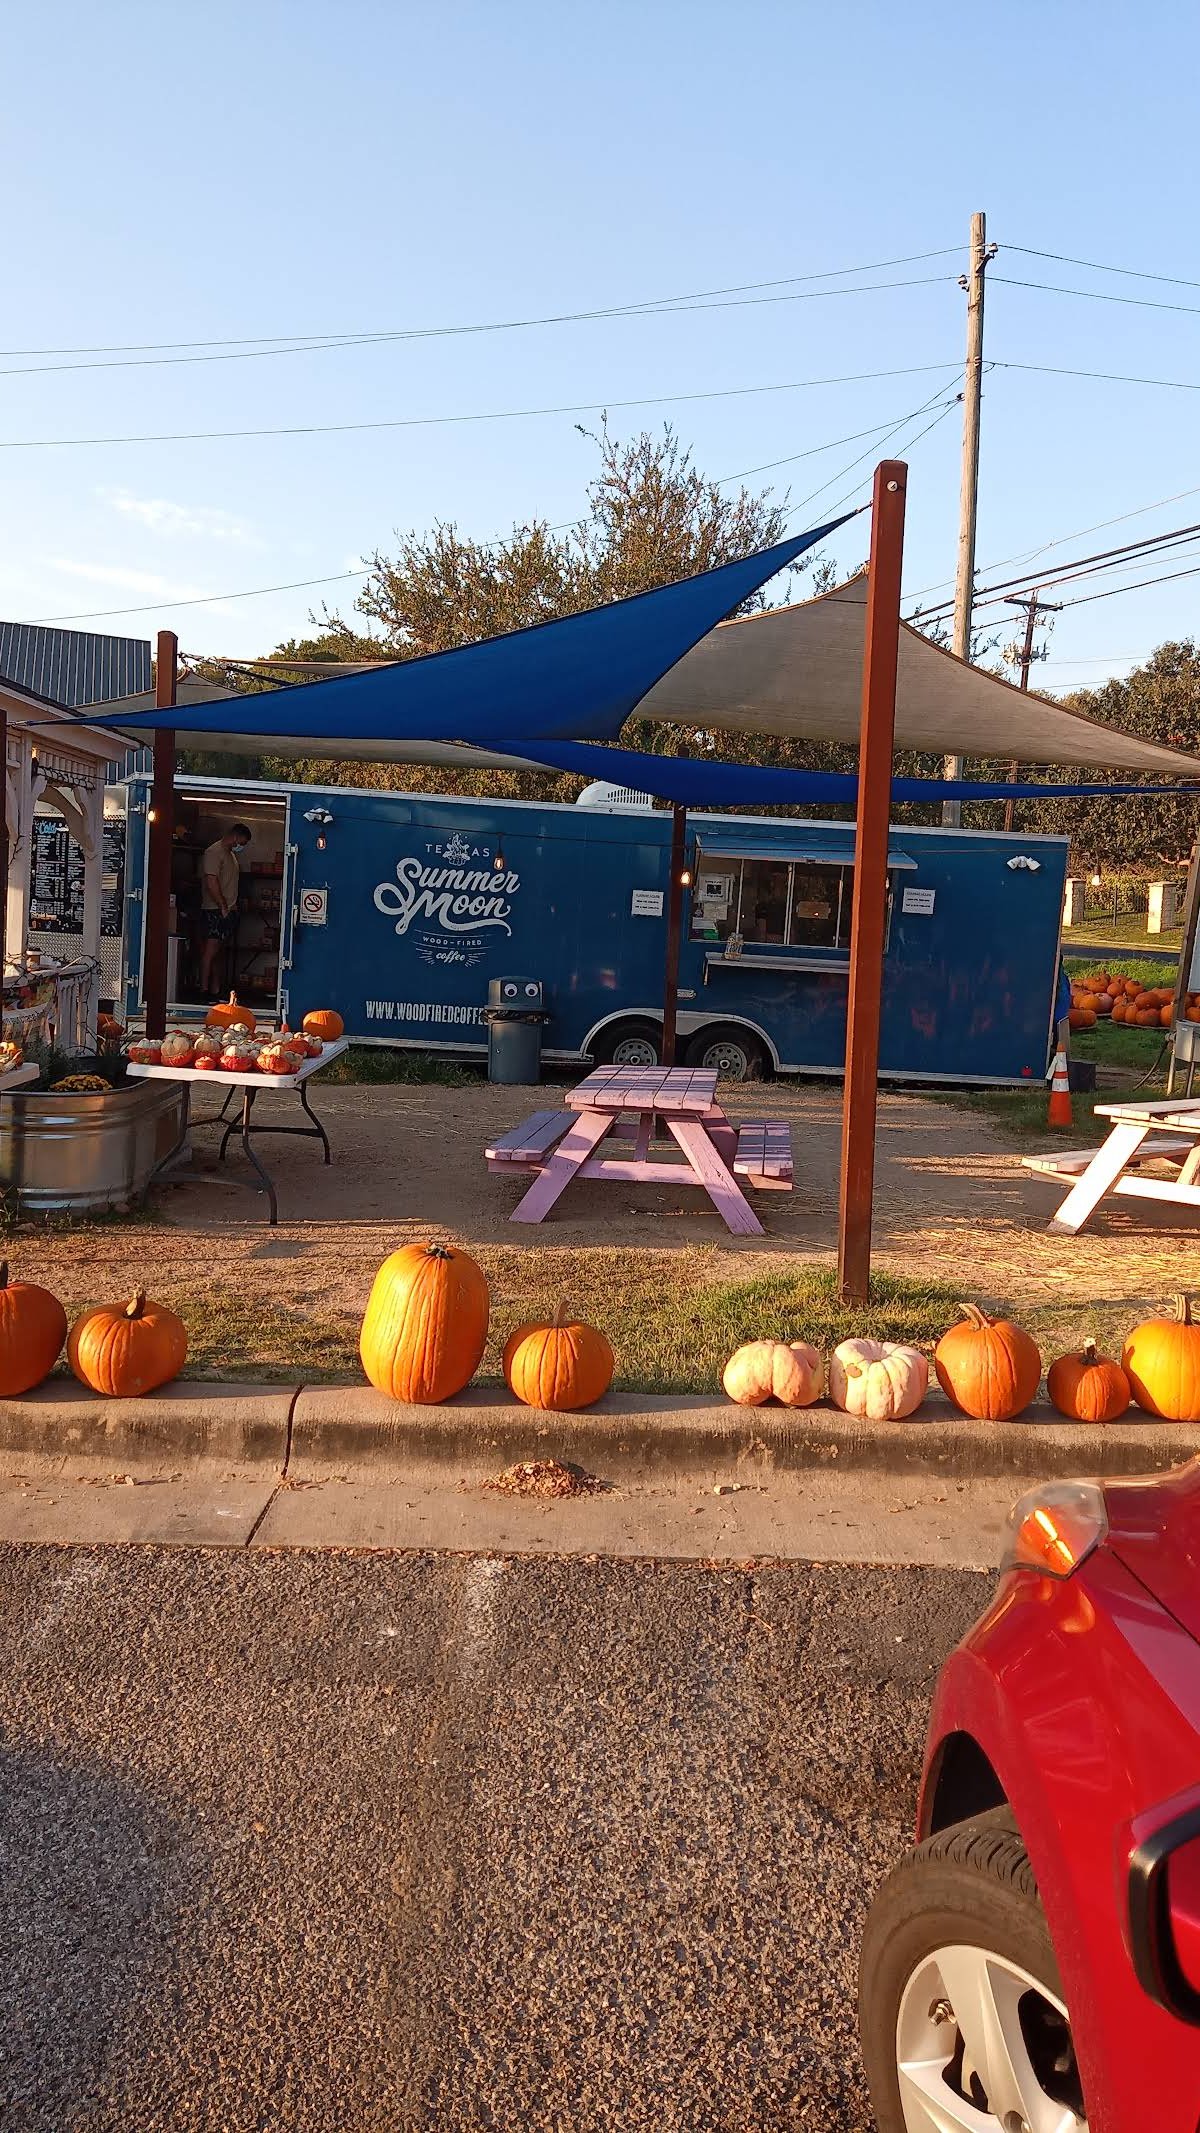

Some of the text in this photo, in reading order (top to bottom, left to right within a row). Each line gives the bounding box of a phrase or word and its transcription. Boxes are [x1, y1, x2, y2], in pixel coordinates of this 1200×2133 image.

[375, 858, 520, 909] Summer
[396, 889, 512, 936] Moon
[435, 950, 466, 963] coffee
[366, 1000, 488, 1026] WWW.WOODFIREDCOFFE
